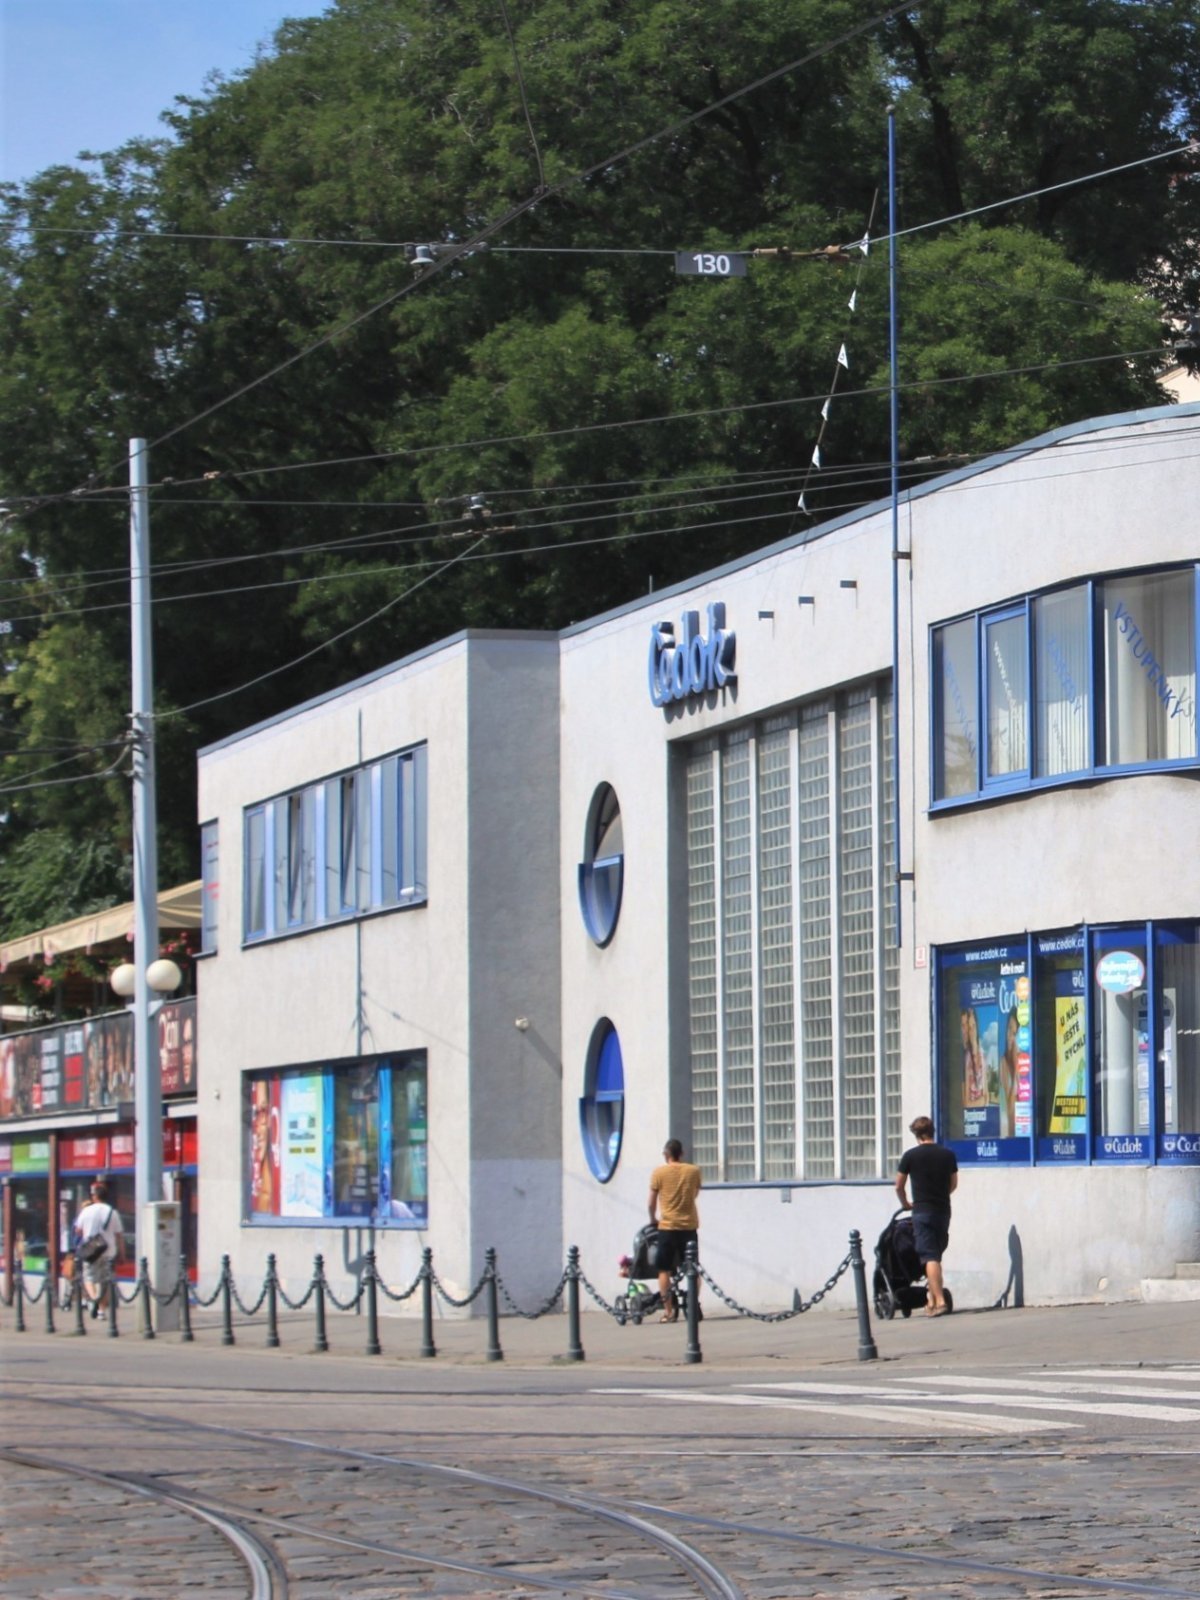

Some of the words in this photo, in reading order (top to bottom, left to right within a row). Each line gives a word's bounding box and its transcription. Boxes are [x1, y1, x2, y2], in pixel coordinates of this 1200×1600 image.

[692, 254, 731, 275] 130
[649, 602, 738, 708] Čedok
[965, 947, 1008, 962] www.cedok.cz
[1112, 1137, 1143, 1154] Čedok
